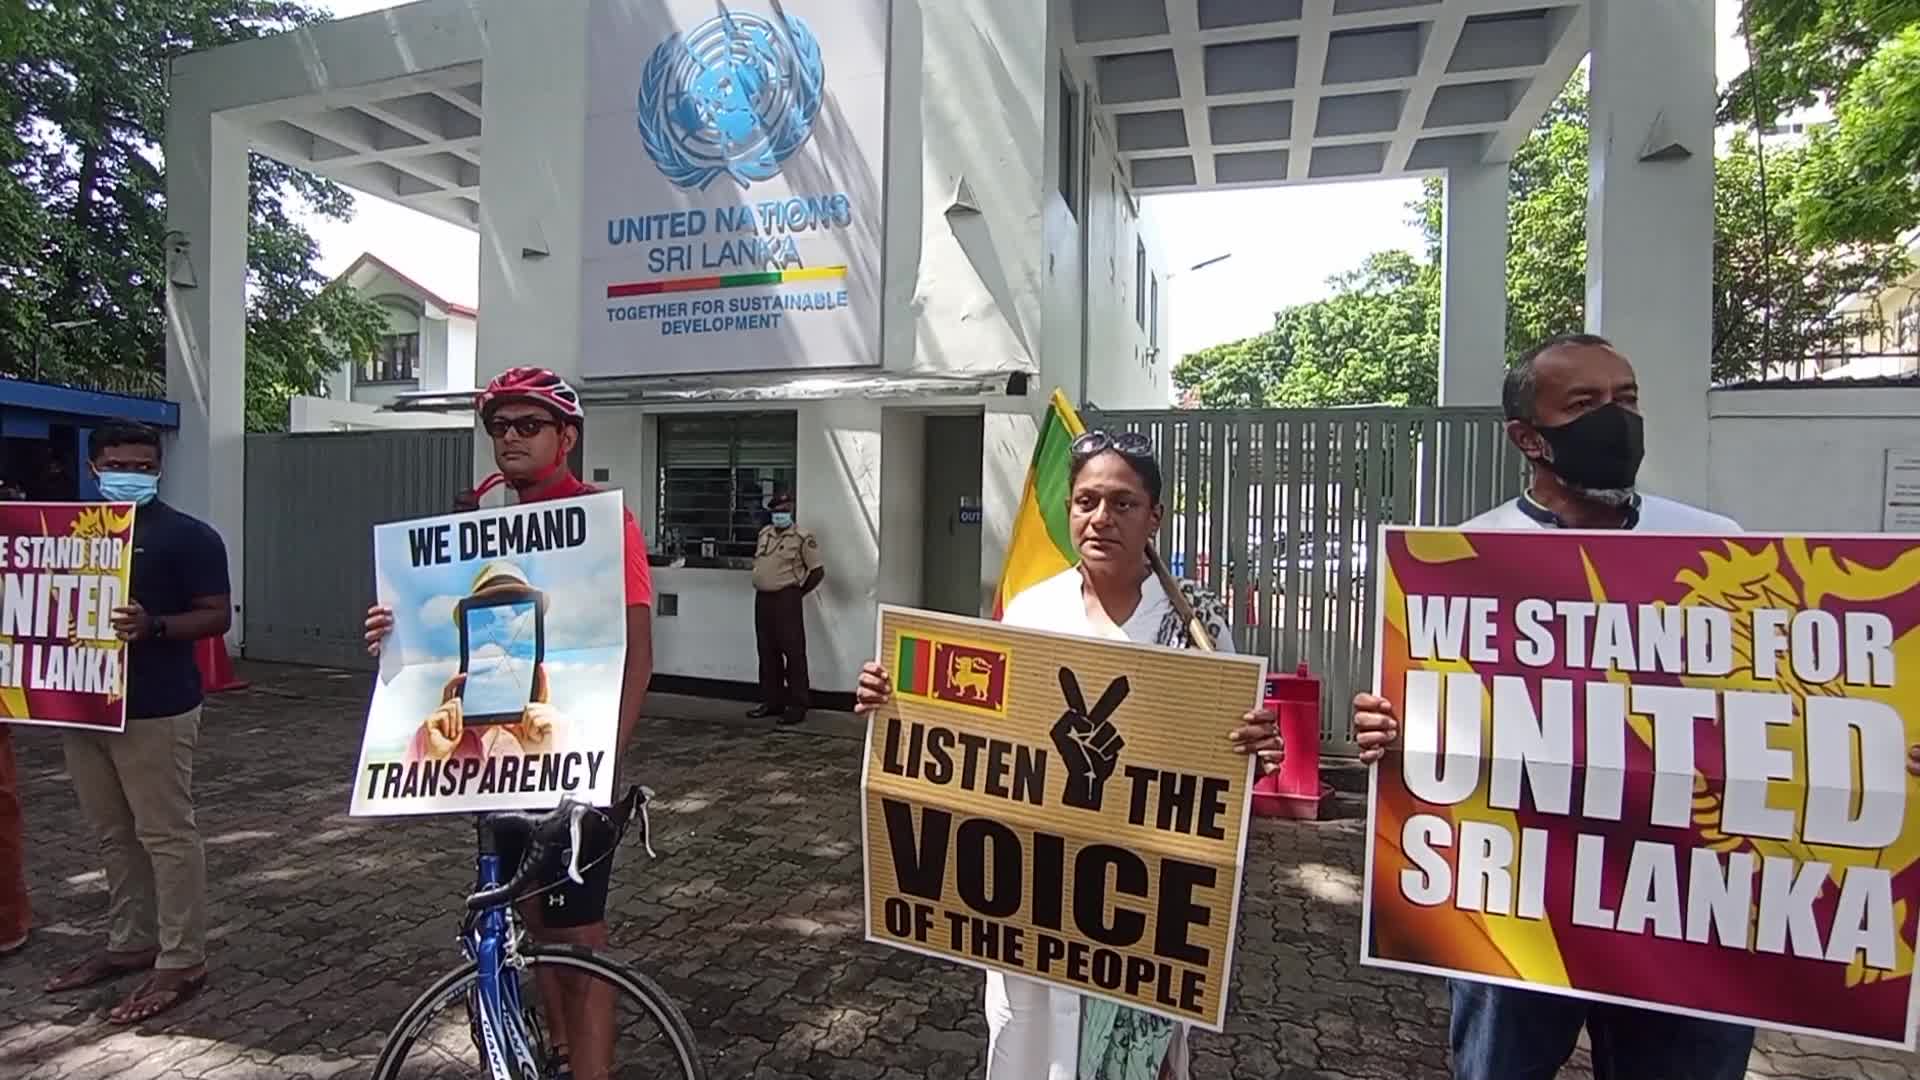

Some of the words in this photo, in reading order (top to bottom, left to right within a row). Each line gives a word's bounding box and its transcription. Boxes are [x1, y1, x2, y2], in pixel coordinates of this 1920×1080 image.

[607, 209, 706, 245] UNITED
[716, 192, 851, 236] NATIONS
[648, 247, 691, 273] SRI
[702, 237, 803, 269] LANKA
[607, 303, 687, 322] TOGETHER
[692, 300, 724, 316] FOR
[729, 291, 848, 313] SUSTAINABLE
[661, 313, 782, 335] DEVELOPMENT
[408, 525, 450, 567] WE
[459, 506, 587, 561] DEMAND
[961, 511, 982, 521] OUT
[0, 536, 9, 567] E
[14, 536, 84, 569] STAND
[90, 537, 123, 569] FOR
[0, 572, 121, 641] NITED
[0, 643, 24, 688] RI
[30, 644, 122, 695] LANKA
[1406, 595, 1498, 664] WE
[1514, 599, 1732, 677] STAND
[1752, 608, 1896, 686] FOR
[367, 750, 604, 800] TRANSPARENCY
[882, 718, 1048, 806] LISTEN
[1125, 765, 1231, 841] THE
[1402, 669, 1906, 849] UNITED
[882, 798, 1218, 967] VOICE
[1400, 814, 1549, 922] SRI
[1572, 833, 1897, 970] LANKA
[884, 897, 935, 942] OF
[944, 910, 1025, 966] THE
[1037, 934, 1206, 1015] PEOPLE
